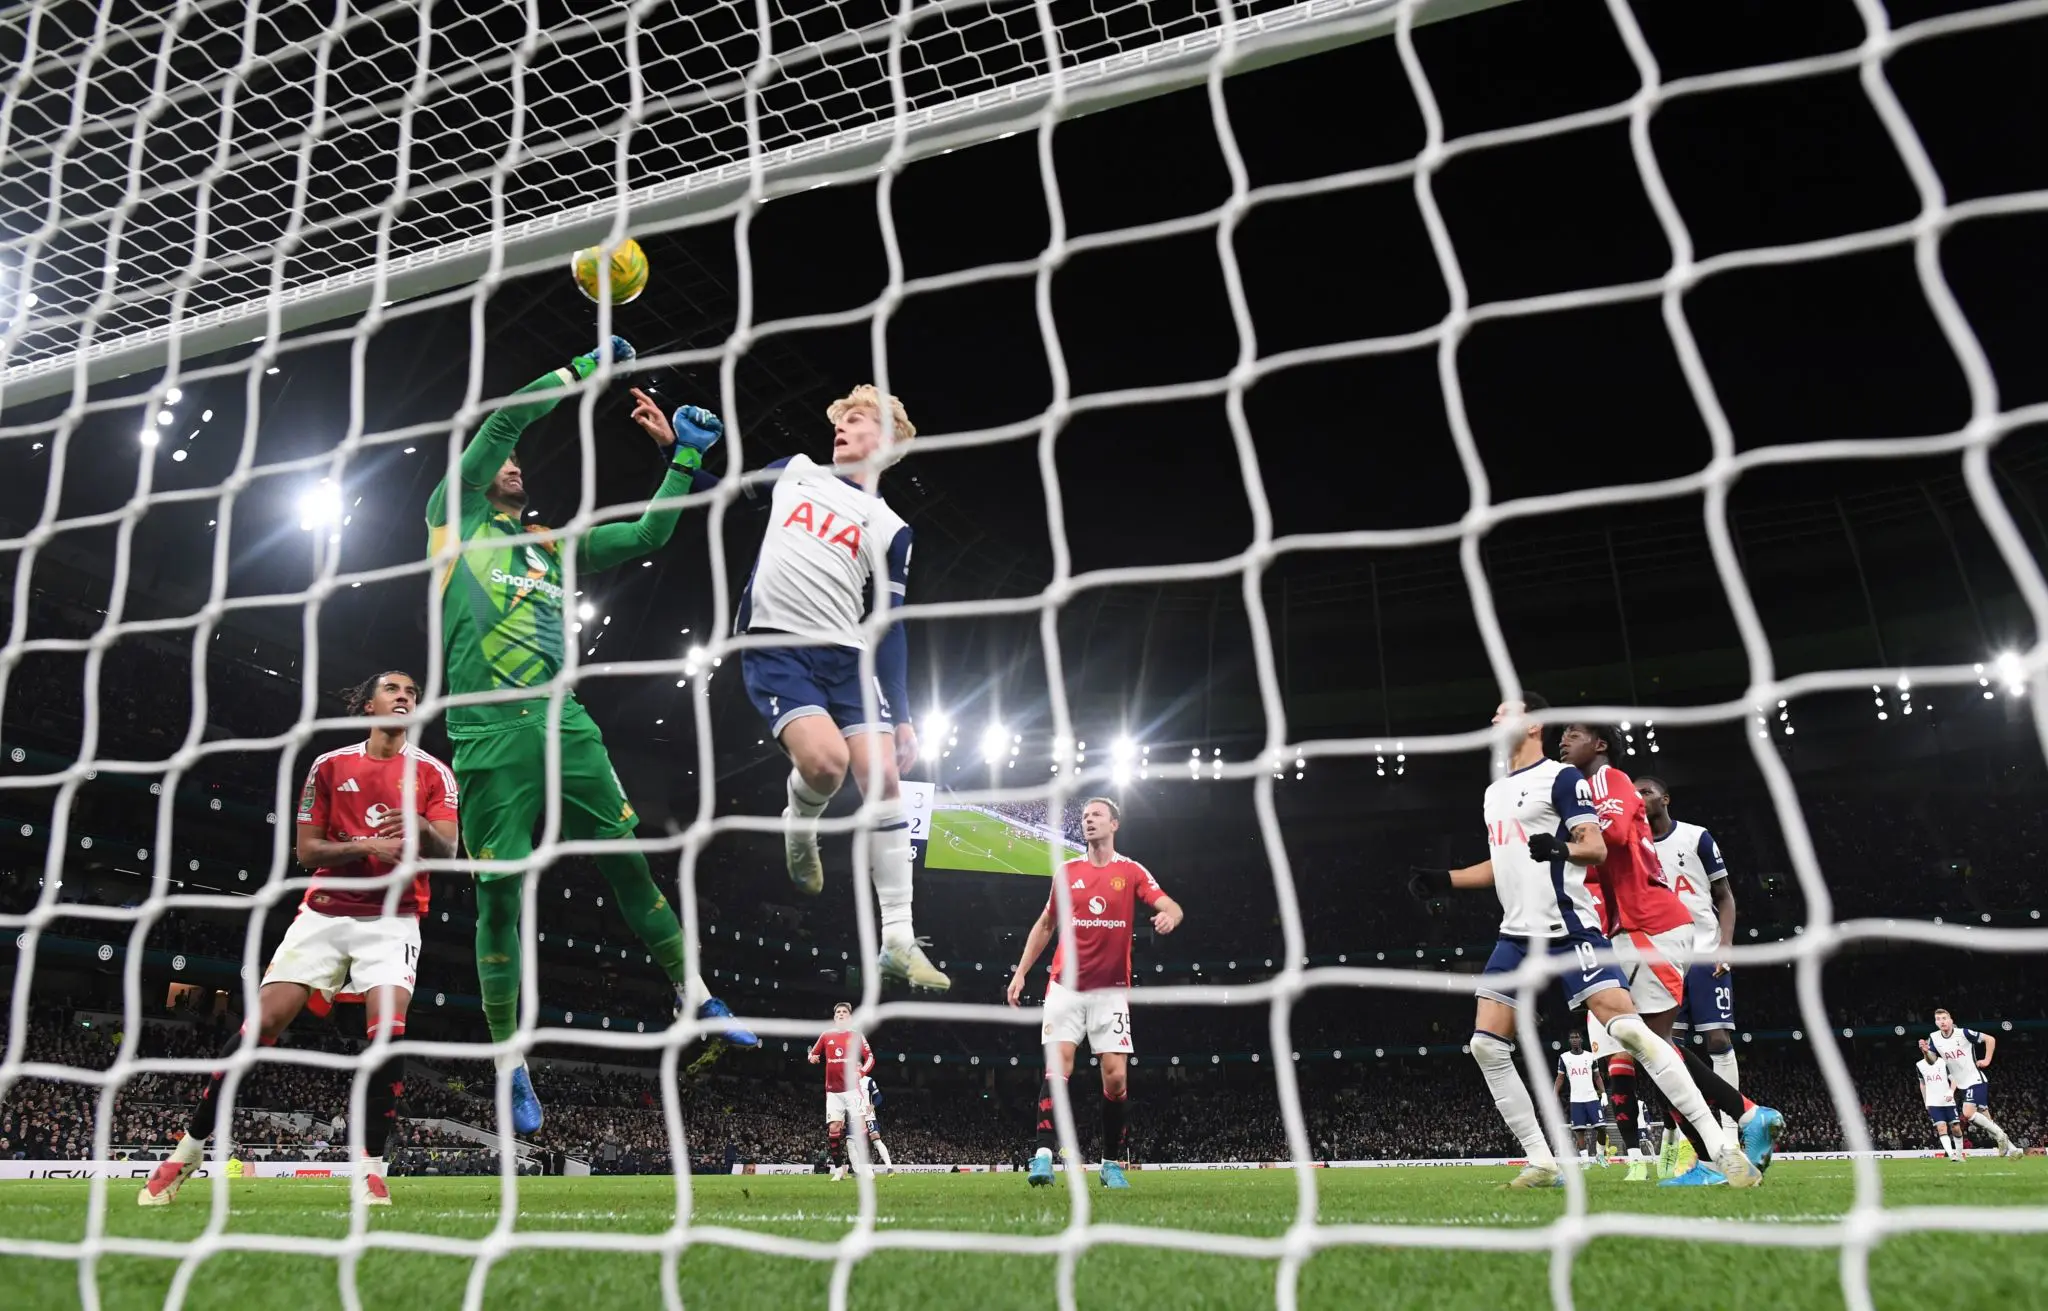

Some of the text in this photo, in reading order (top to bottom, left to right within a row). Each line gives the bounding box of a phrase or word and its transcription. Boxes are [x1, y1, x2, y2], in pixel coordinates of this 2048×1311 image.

[783, 502, 862, 560] AIA
[912, 792, 924, 809] 3
[910, 817, 922, 834] 2
[1071, 916, 1126, 929] Snapdragon
[1574, 941, 1598, 971] 19
[1714, 986, 1731, 1010] 29
[1944, 1049, 1966, 1060] AIA
[1570, 1067, 1589, 1076] AIA
[1926, 1073, 1943, 1082] AIA
